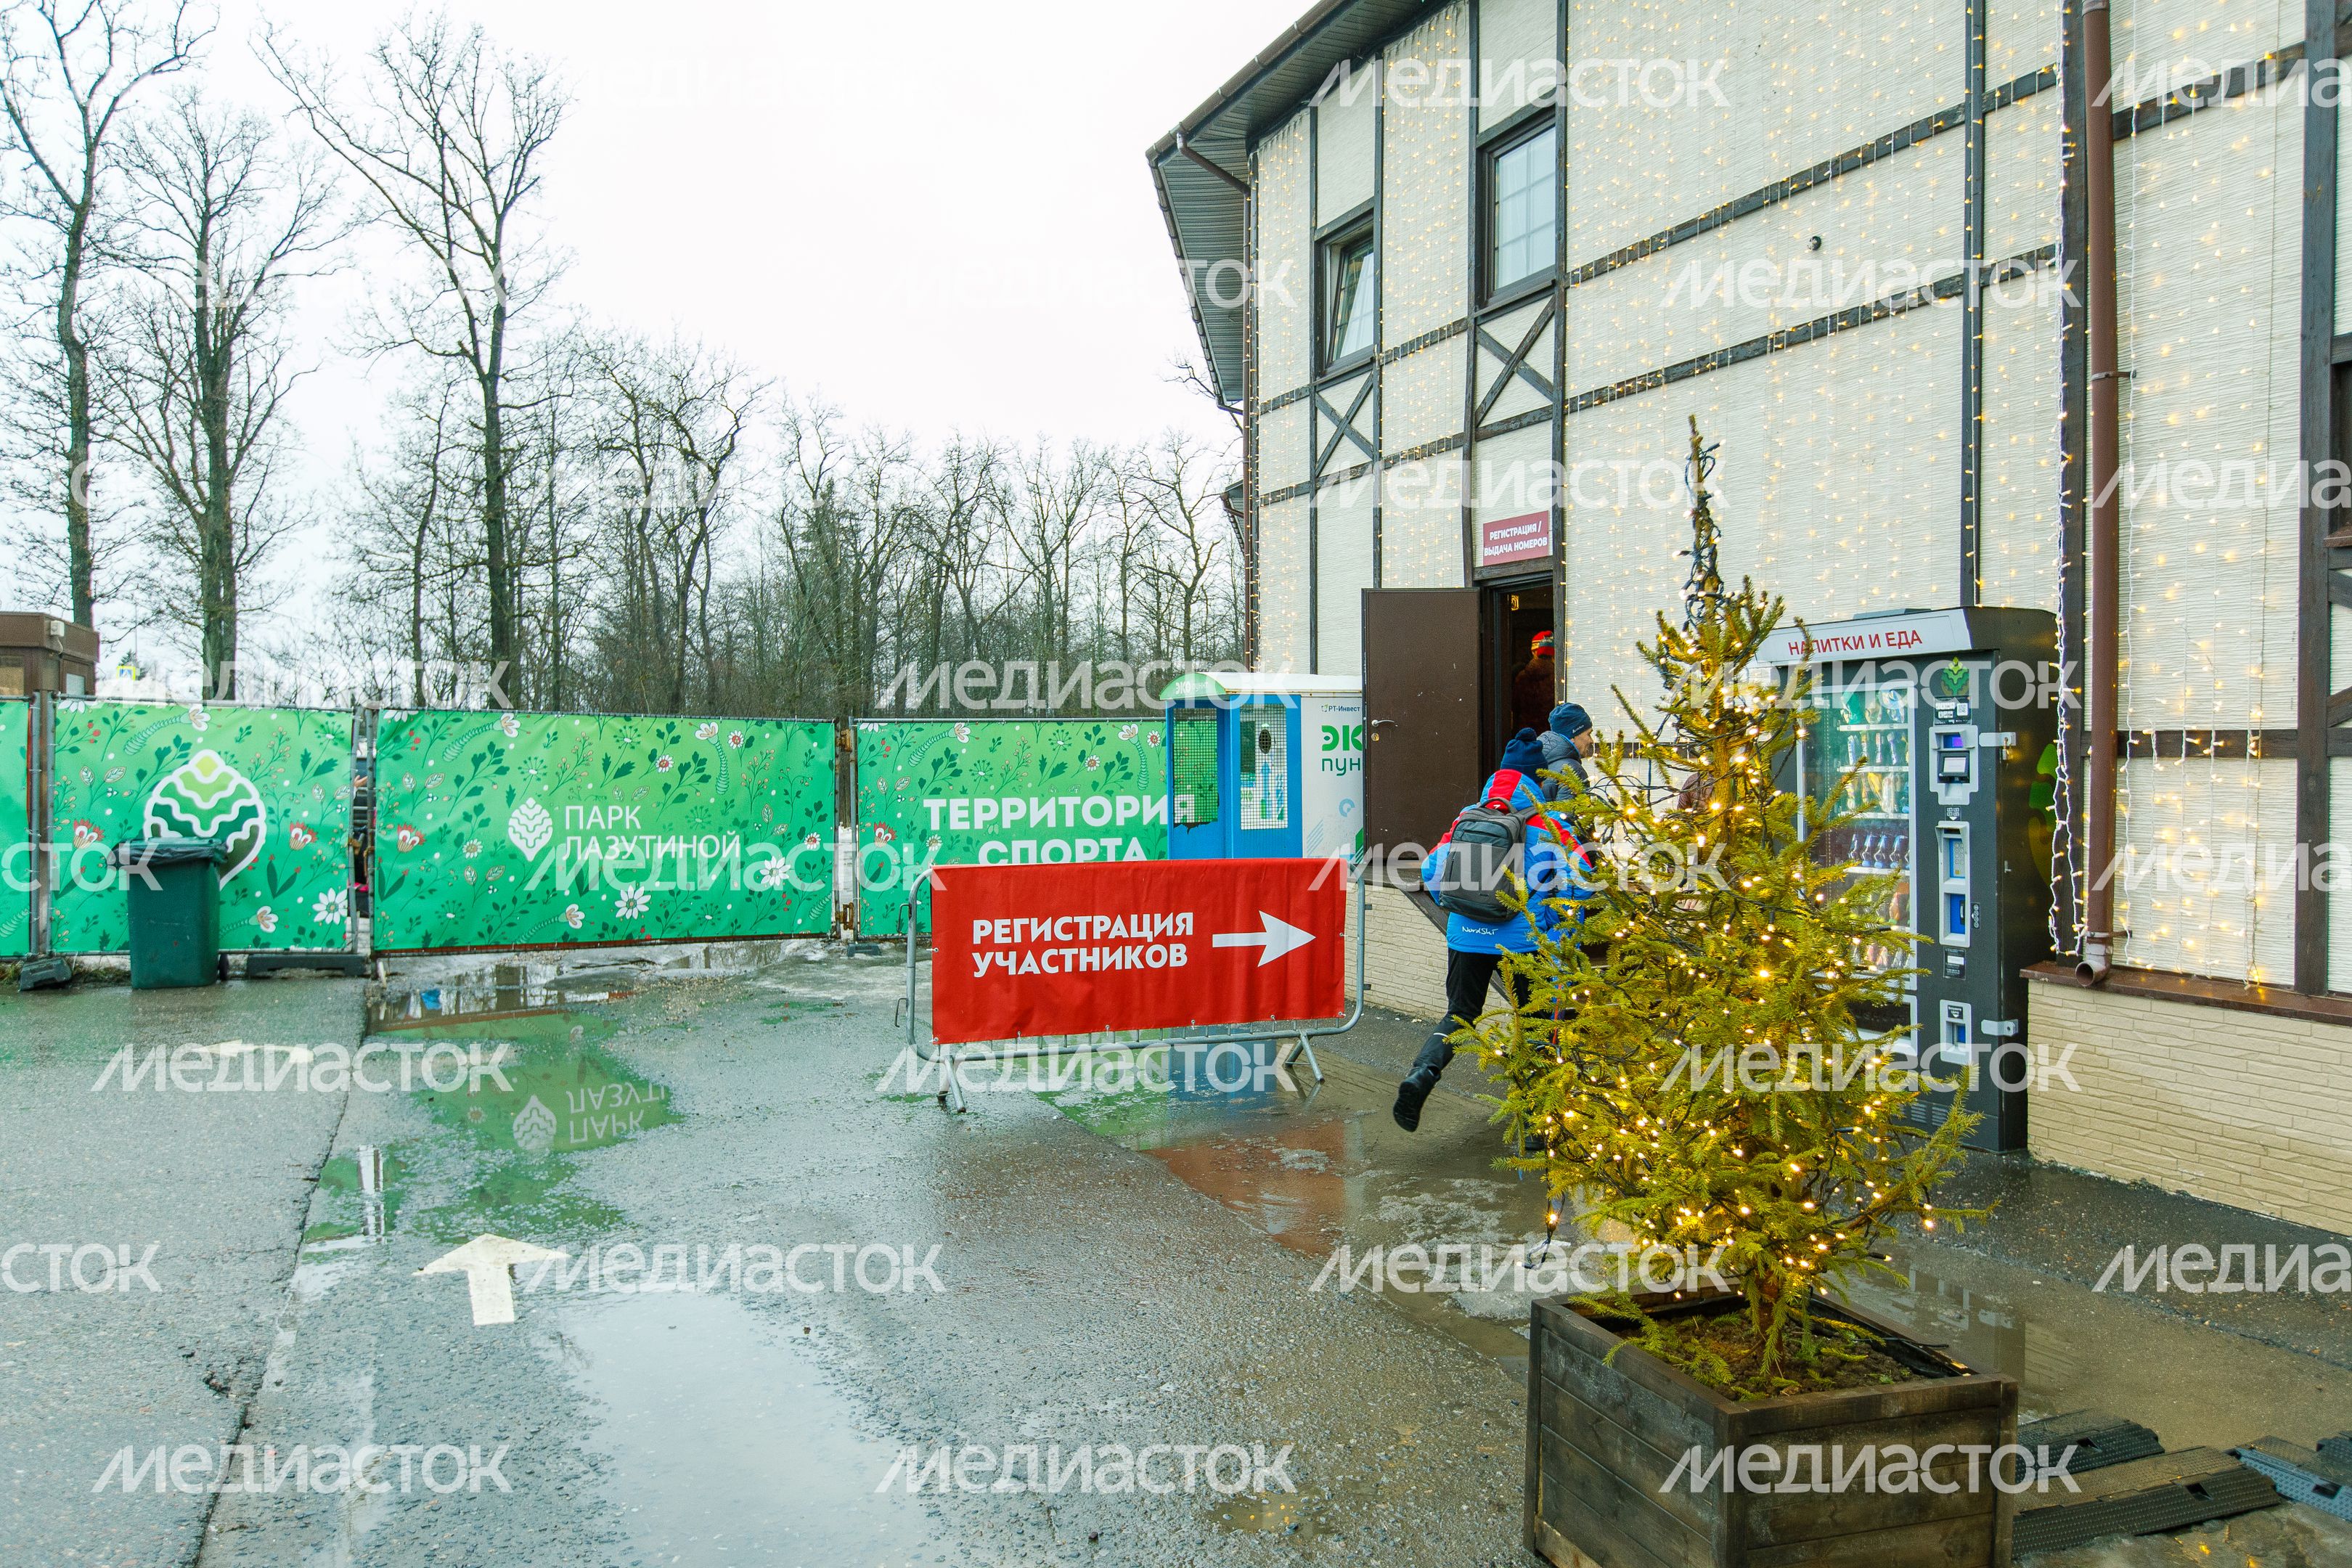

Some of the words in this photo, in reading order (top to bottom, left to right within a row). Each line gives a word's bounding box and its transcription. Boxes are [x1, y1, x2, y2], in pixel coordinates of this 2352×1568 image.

[1490, 523, 1537, 540] РЕГИСТРАЦИЯ
[1485, 542, 1513, 557] ВЫДАЧА
[1514, 537, 1548, 551] НОМЕРОВ
[1869, 633, 1881, 648] И
[1885, 629, 1922, 650] ЕДА
[1321, 724, 1363, 751] ЭК
[1321, 758, 1361, 776] пун
[565, 805, 642, 830] ПАРК
[562, 830, 740, 860] ЛАЗУТИНОЙ
[978, 836, 1148, 865] СПОРТА
[973, 912, 1194, 944] РЕГИСТРАЦИЯ
[971, 943, 1188, 978] УЧАСТНИКОВ
